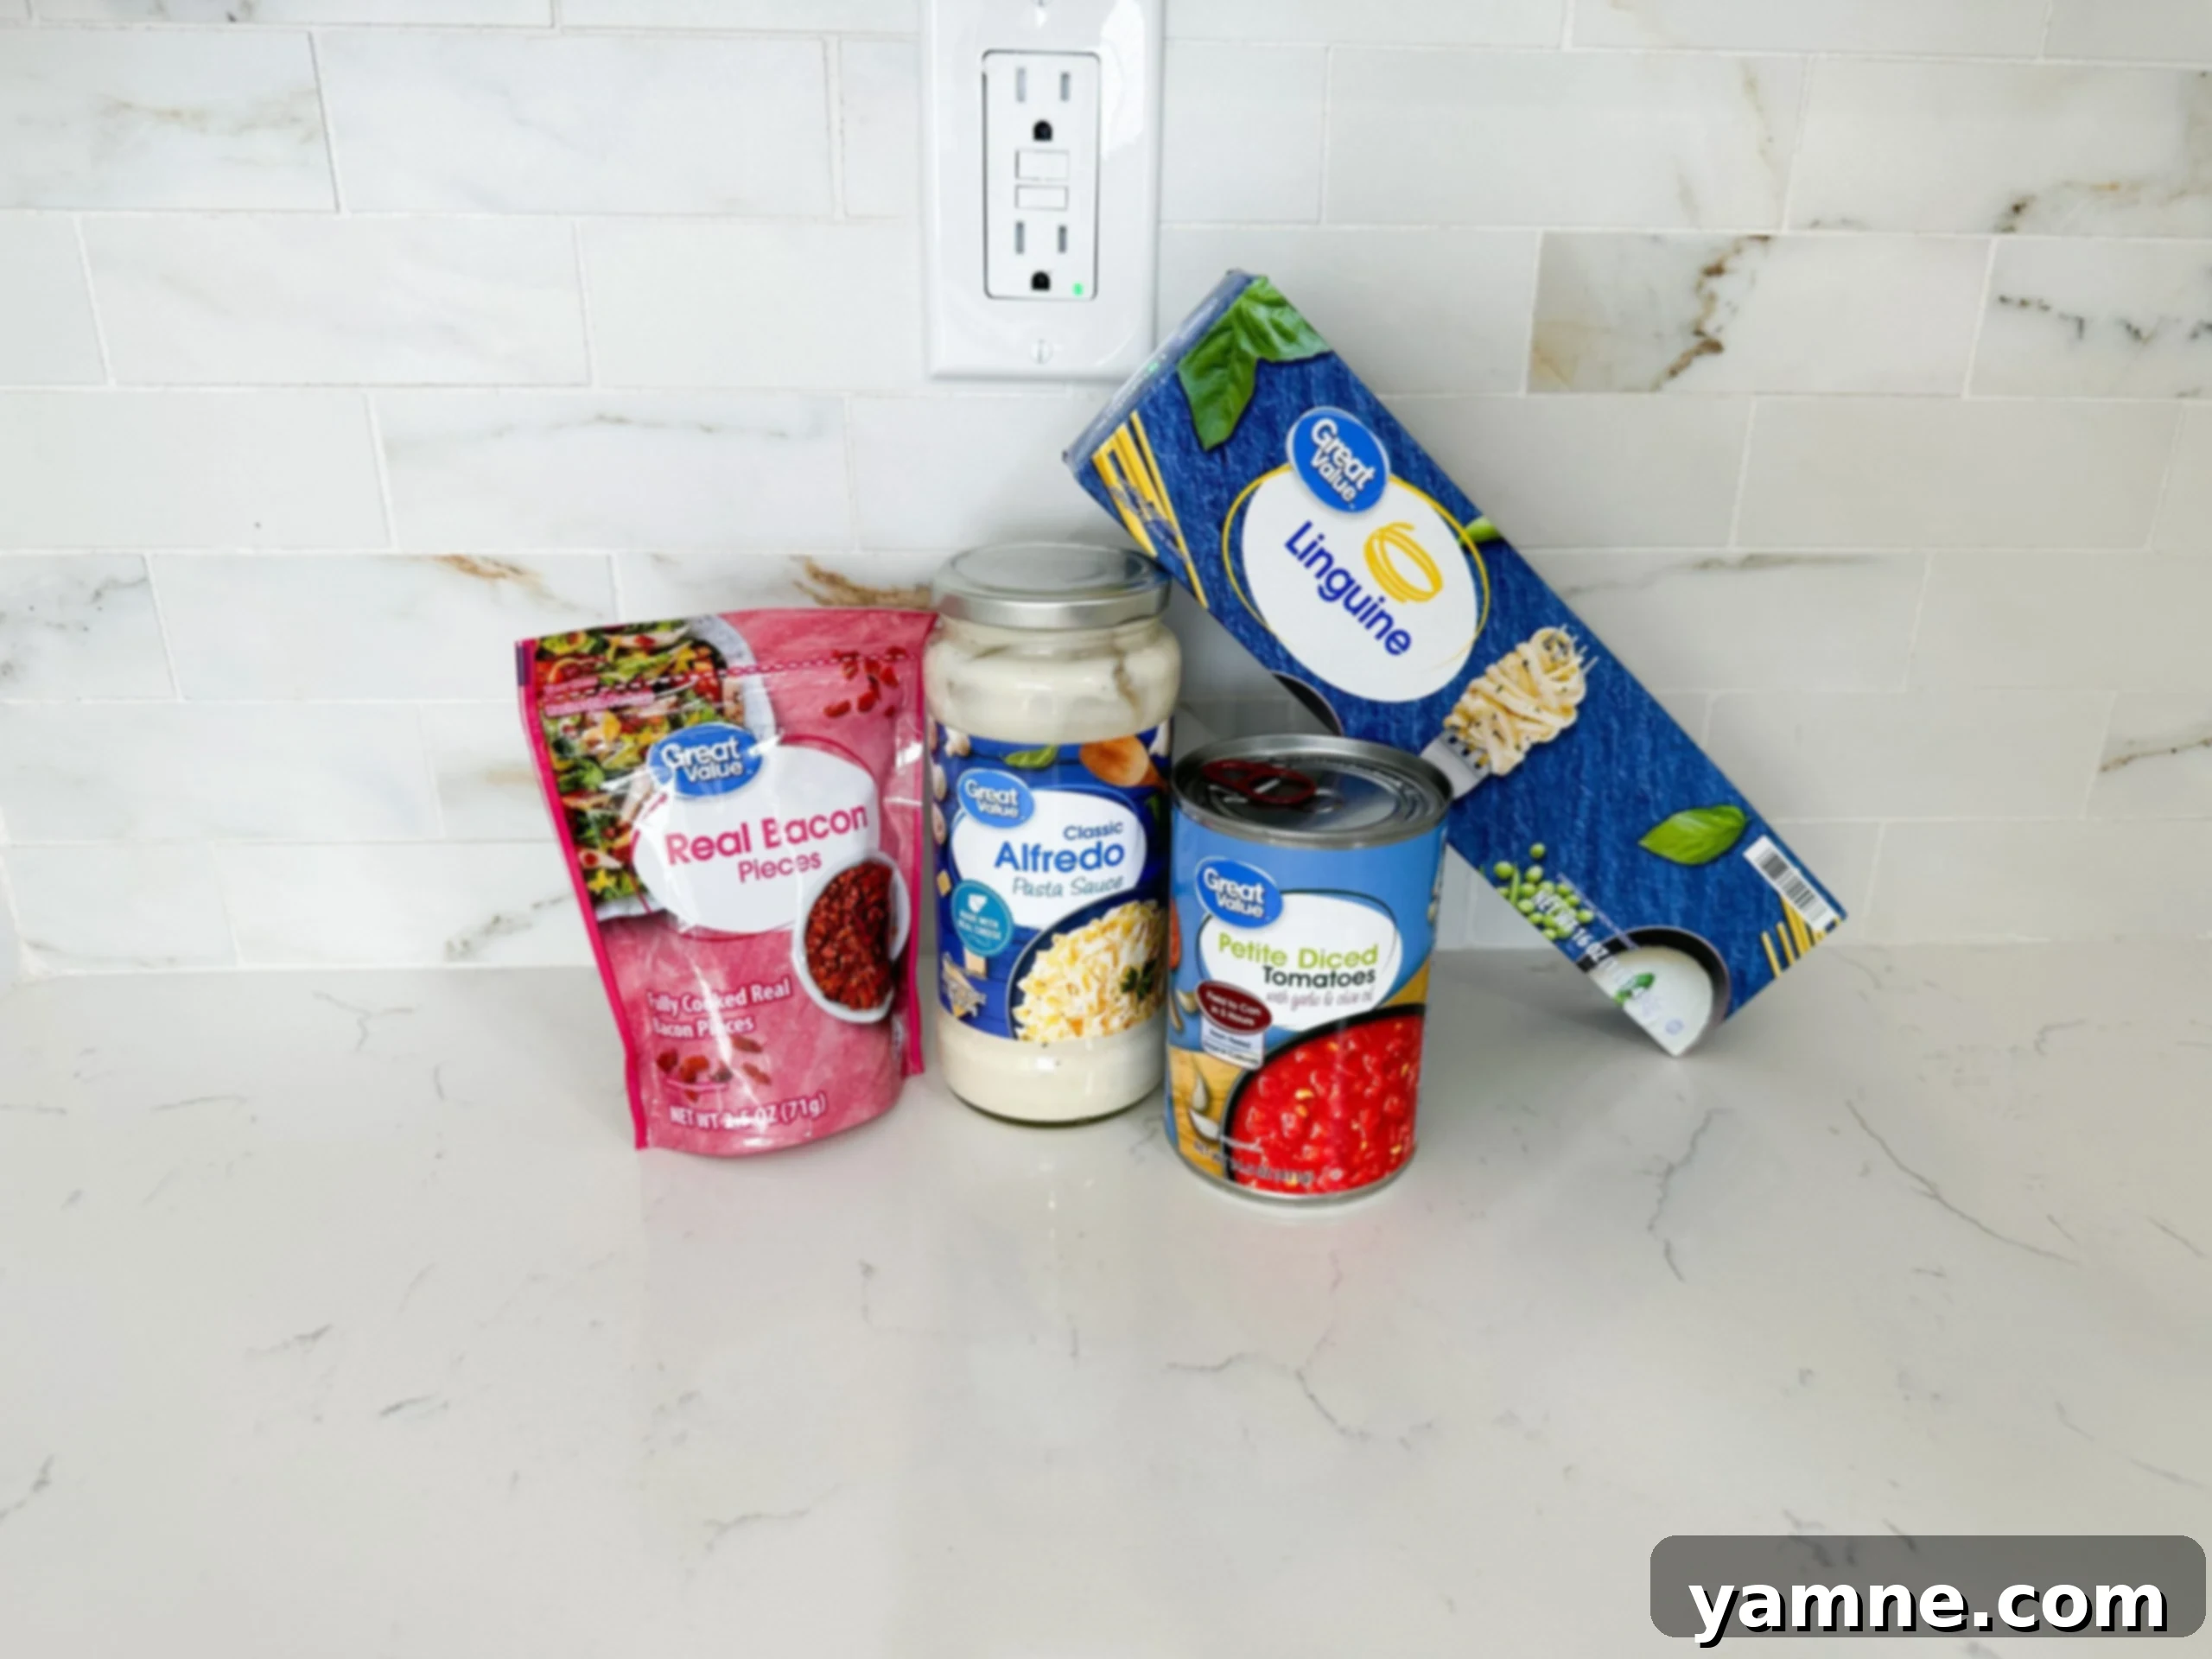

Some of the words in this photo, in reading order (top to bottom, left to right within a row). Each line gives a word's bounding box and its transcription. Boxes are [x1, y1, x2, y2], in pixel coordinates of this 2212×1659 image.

[1311, 418, 1375, 490] Great
[1309, 450, 1357, 504] Value
[1284, 521, 1413, 657] Linguine
[661, 736, 741, 769] Great
[683, 761, 743, 783] Value
[964, 779, 1020, 806] Great
[977, 799, 1020, 818] Value
[664, 823, 752, 867] Real
[1063, 821, 1124, 842] Classic
[737, 850, 823, 883] Pieces
[995, 841, 1125, 873] Alfredo
[1012, 876, 1064, 898] Pasta
[1071, 874, 1125, 896] Sauce
[1204, 868, 1265, 904] Great
[1216, 891, 1264, 918] Value
[1219, 931, 1287, 966] Petite
[1299, 944, 1379, 969] Diced
[1572, 928, 1592, 948] 16
[751, 977, 791, 1002] Real
[1262, 966, 1376, 988] Tomatoes
[670, 1105, 694, 1125] NET
[696, 1111, 718, 1129] WT
[781, 1091, 827, 1122] (71g)
